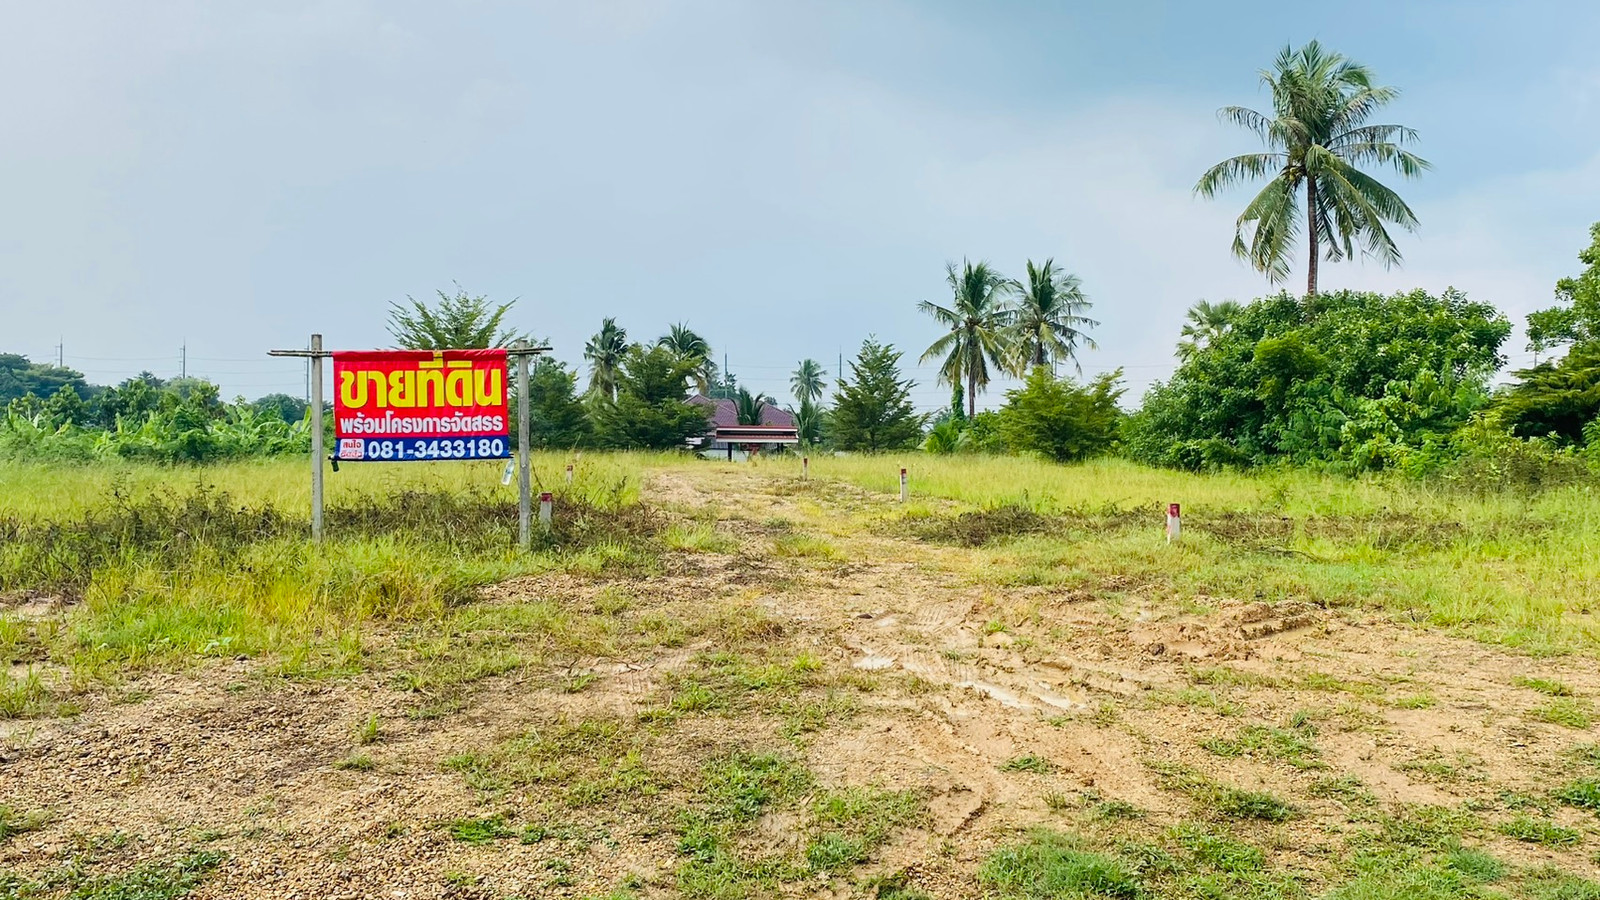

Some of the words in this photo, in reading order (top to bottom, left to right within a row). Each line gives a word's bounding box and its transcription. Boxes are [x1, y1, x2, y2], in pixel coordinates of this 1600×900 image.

[340, 350, 502, 409] ขายที่ดิน
[340, 411, 503, 434] พร้อมโครงการจัดสรร
[343, 439, 362, 448] สนใจ
[367, 438, 504, 459] 081-3433180
